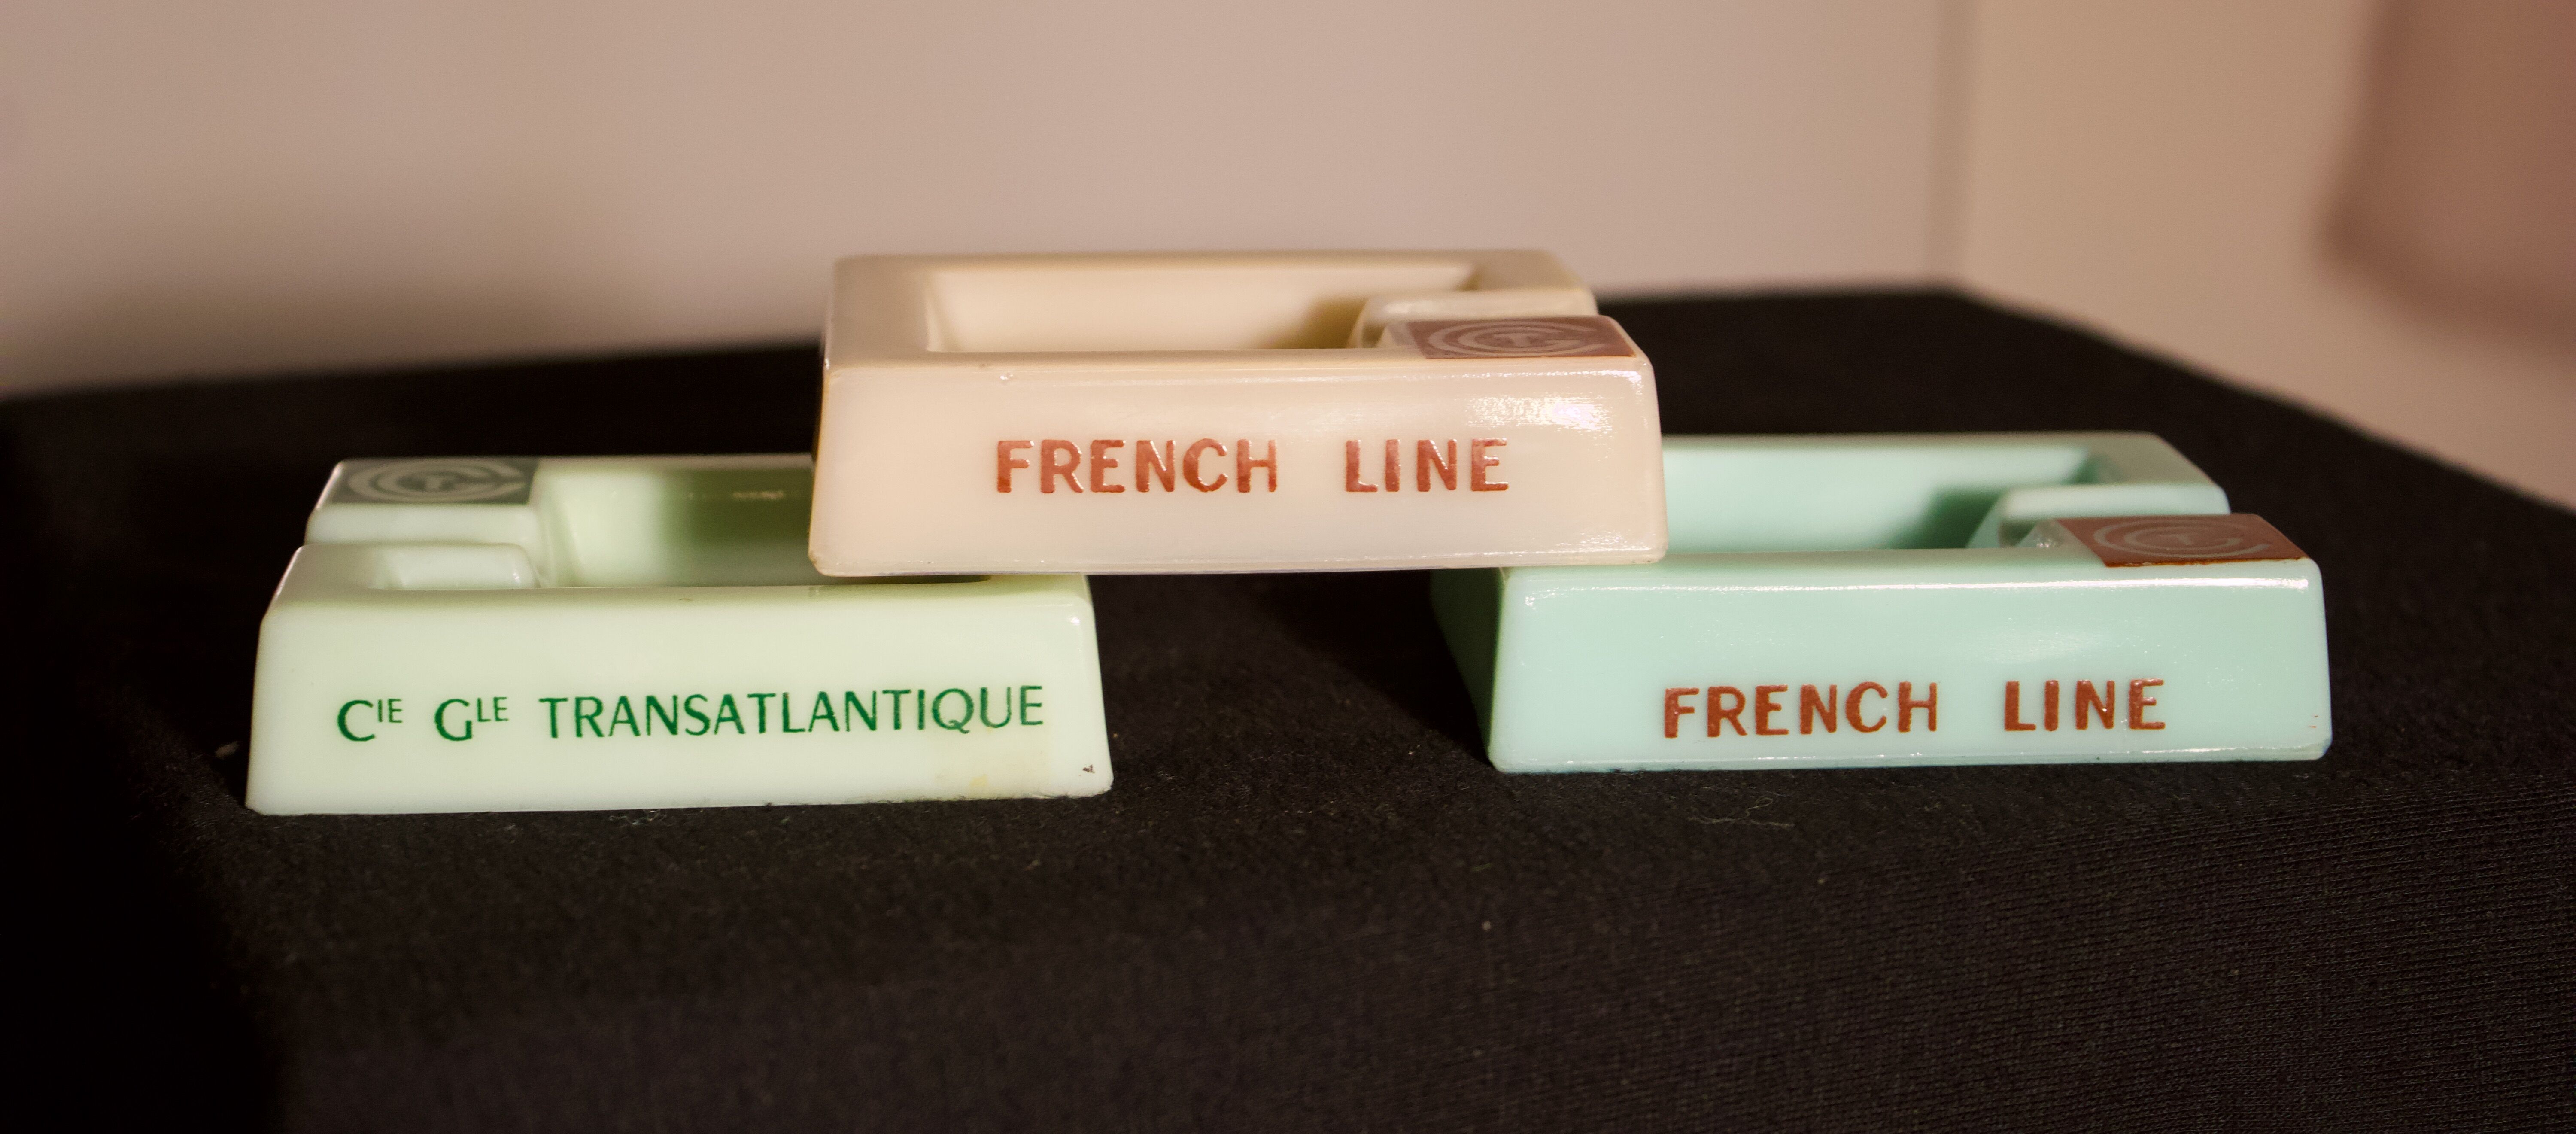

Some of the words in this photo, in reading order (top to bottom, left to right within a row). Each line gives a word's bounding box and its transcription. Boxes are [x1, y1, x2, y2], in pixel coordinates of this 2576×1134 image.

[996, 438, 1278, 494] FRENCH
[1345, 438, 1509, 493] LINE
[538, 685, 1044, 739] TRANSATLANTIQUE
[1664, 681, 1938, 739] FRENCH
[2004, 678, 2166, 732] LINE
